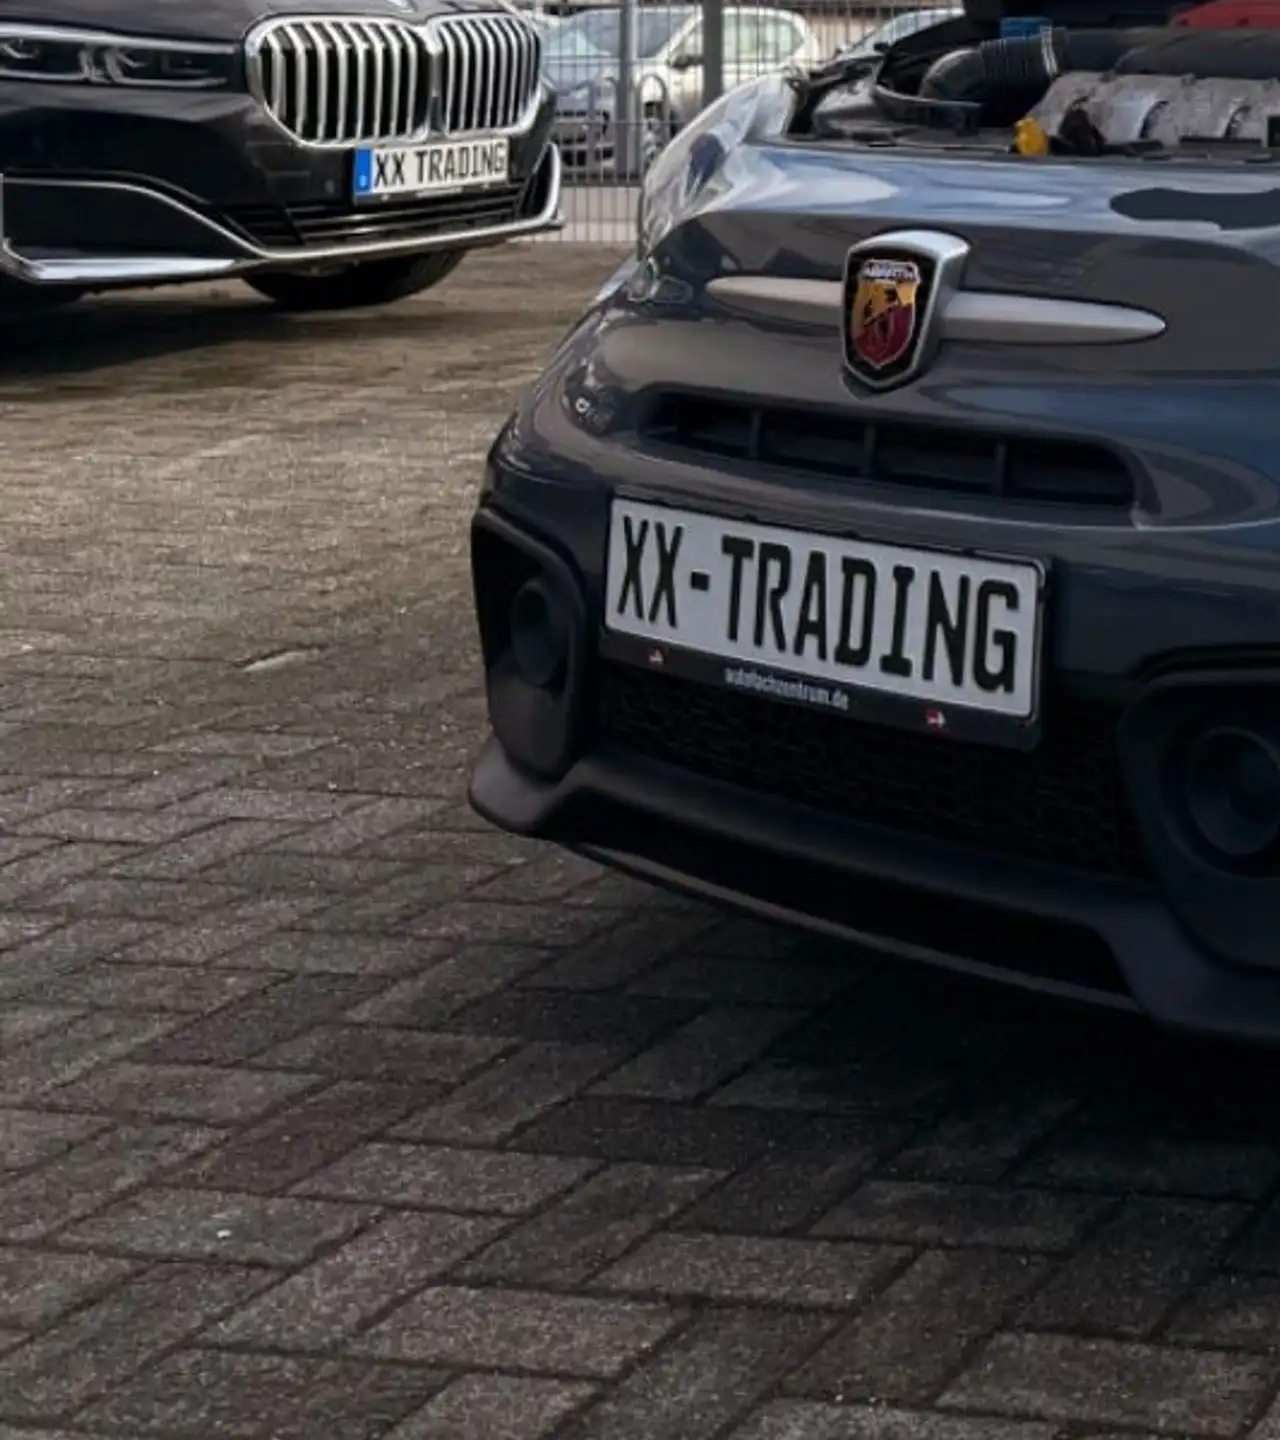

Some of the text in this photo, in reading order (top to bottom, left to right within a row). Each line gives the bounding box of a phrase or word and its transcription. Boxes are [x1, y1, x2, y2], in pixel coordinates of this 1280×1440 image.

[375, 143, 505, 187] XX TRADING
[617, 515, 1019, 694] XX-TRADING
